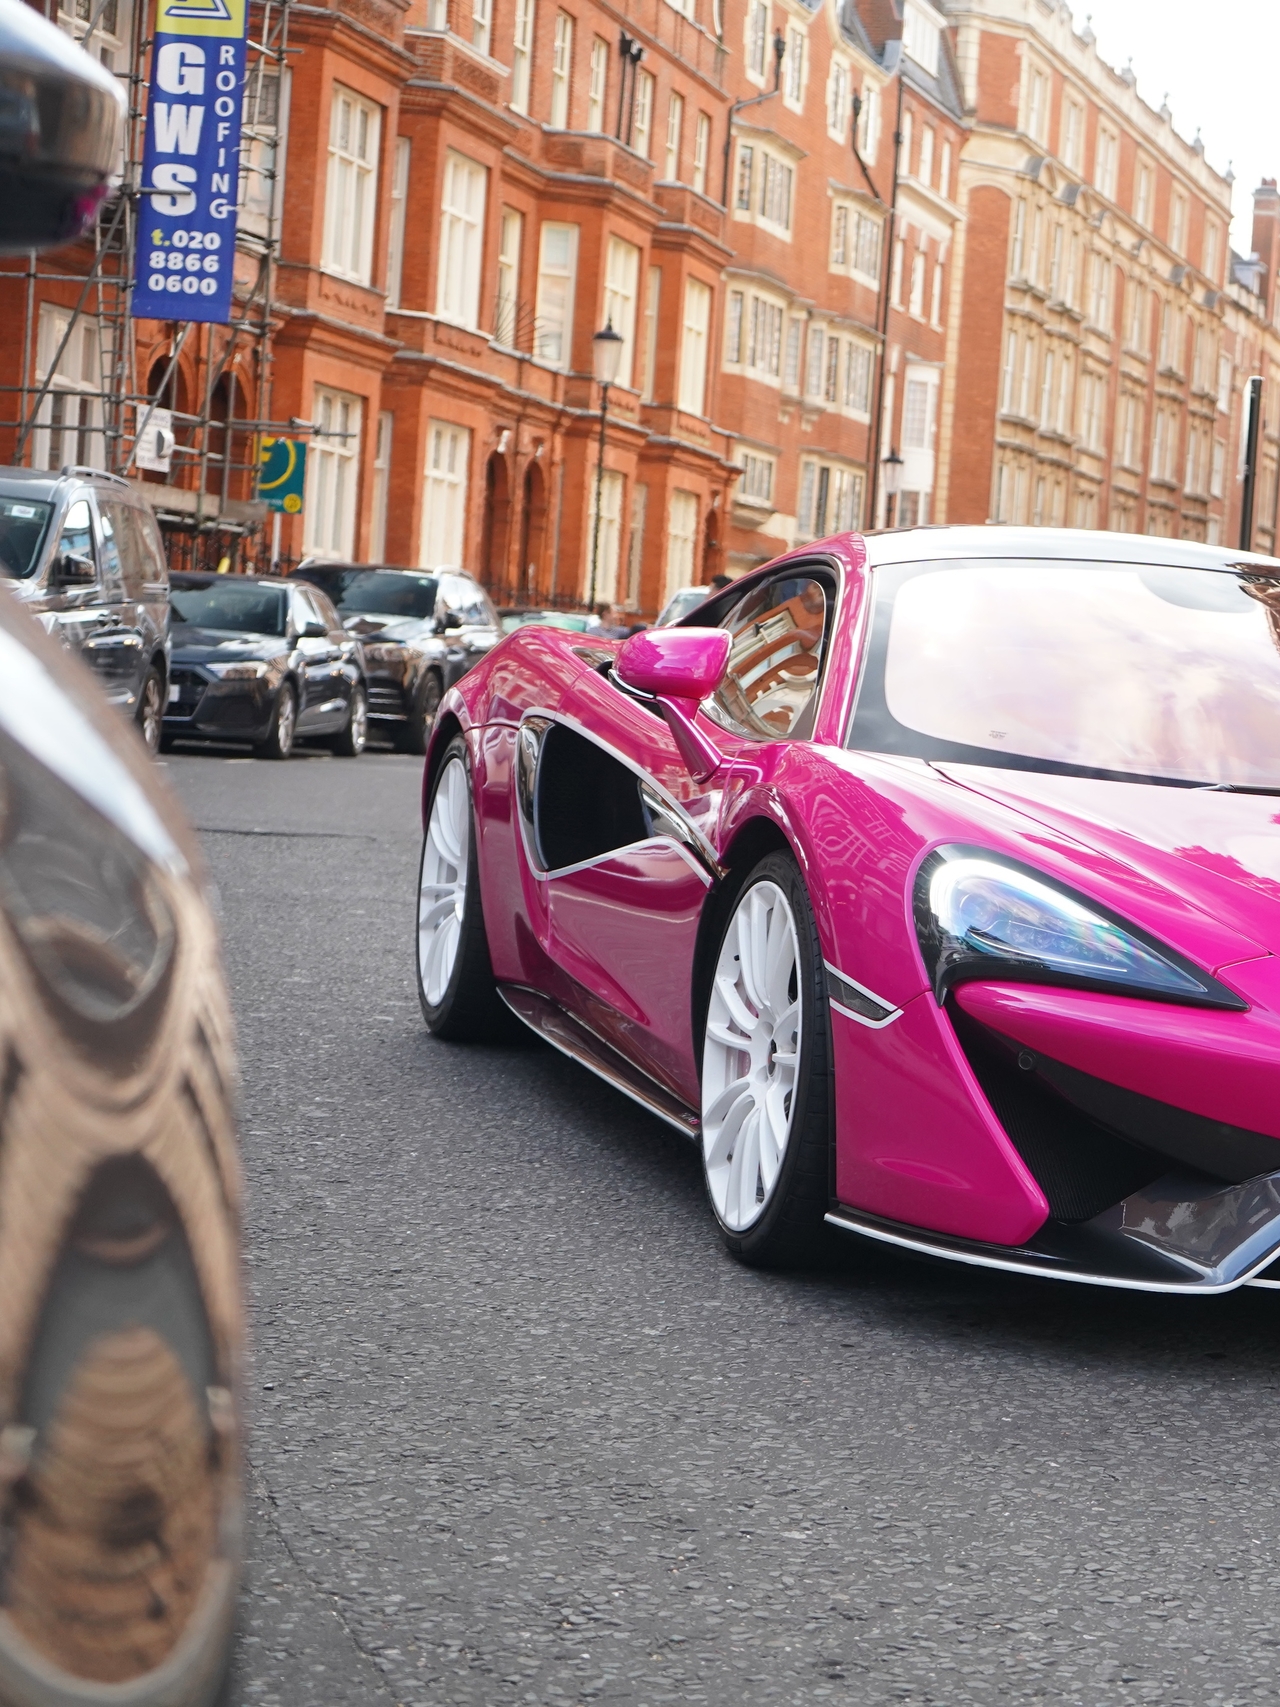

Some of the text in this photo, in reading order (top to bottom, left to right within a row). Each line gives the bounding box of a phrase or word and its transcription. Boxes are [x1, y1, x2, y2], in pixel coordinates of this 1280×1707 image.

[151, 42, 206, 217] GWS
[209, 45, 237, 219] ROOFING
[148, 251, 219, 272] 8866
[148, 273, 218, 296] 0600
